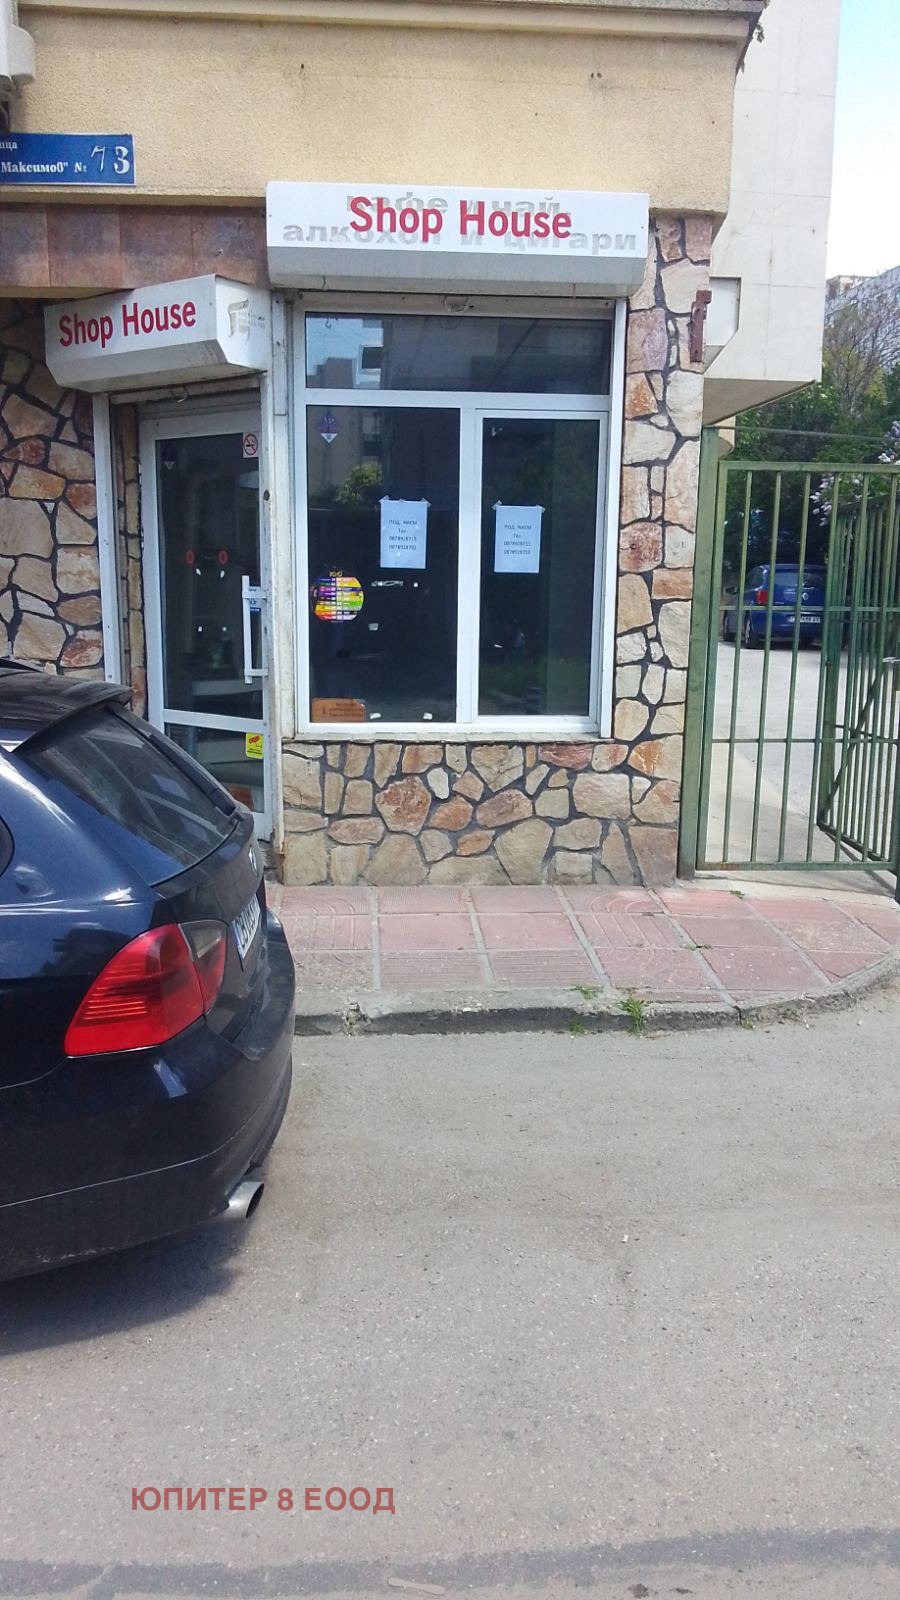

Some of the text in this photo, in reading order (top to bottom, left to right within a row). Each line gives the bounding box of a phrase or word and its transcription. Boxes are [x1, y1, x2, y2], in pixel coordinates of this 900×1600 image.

[350, 196, 572, 243] Shop House
[59, 301, 196, 348] Shop House
